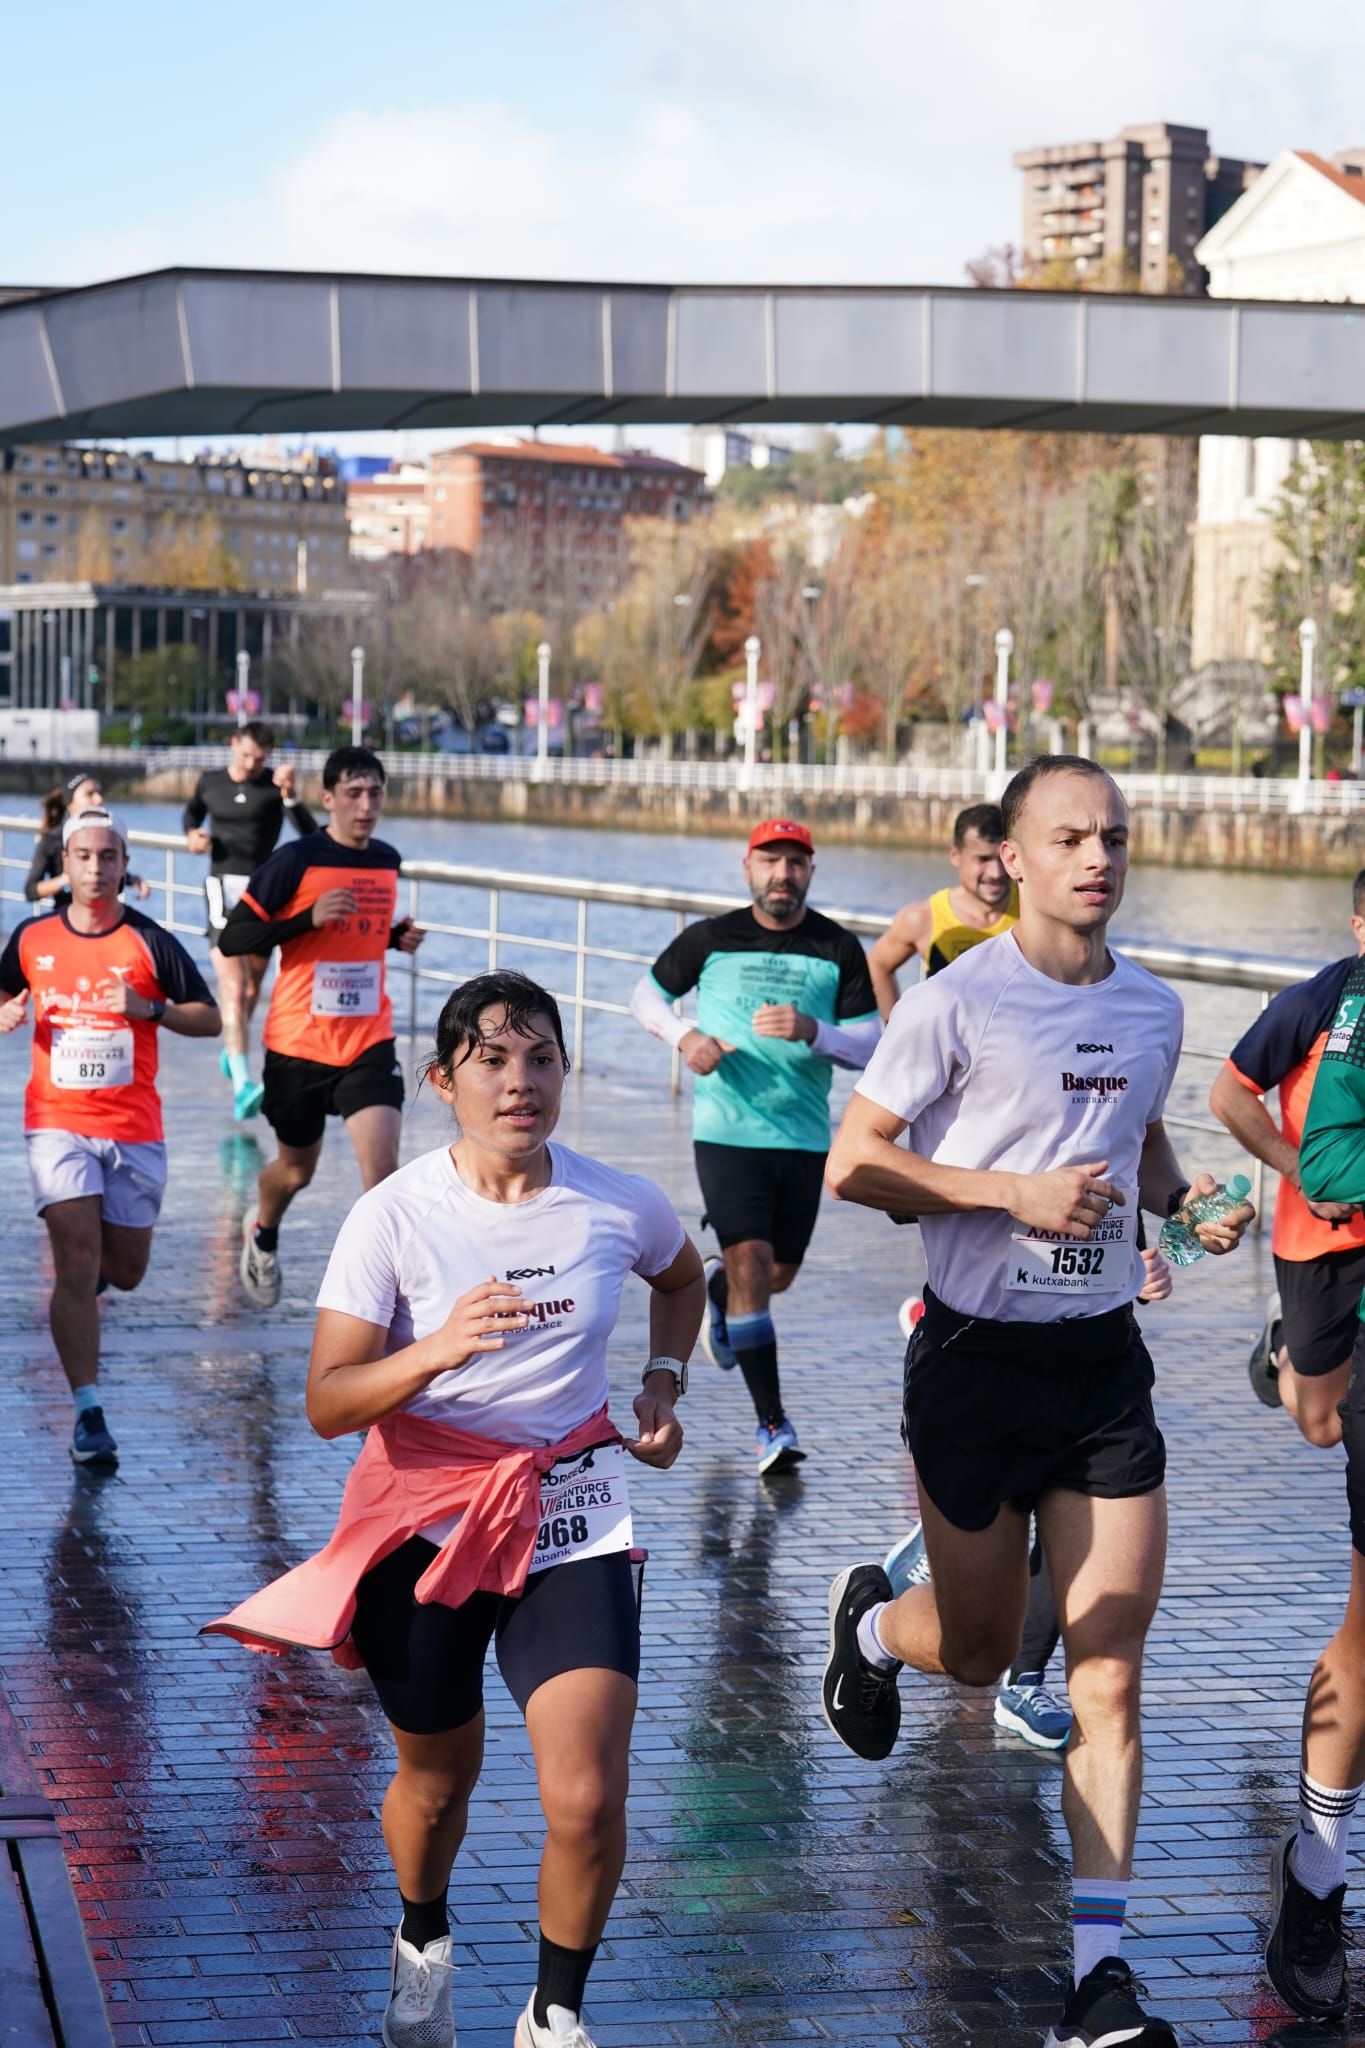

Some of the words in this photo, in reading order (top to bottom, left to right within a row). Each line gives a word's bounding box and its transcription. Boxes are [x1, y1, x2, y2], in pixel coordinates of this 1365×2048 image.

[79, 1063, 106, 1078] 873
[1061, 1072, 1129, 1096] Basque
[1091, 1229, 1123, 1242] ILBAO
[1051, 1247, 1105, 1275] 1532
[1032, 1275, 1090, 1288] kutxabank
[555, 1492, 612, 1512] BILBAO
